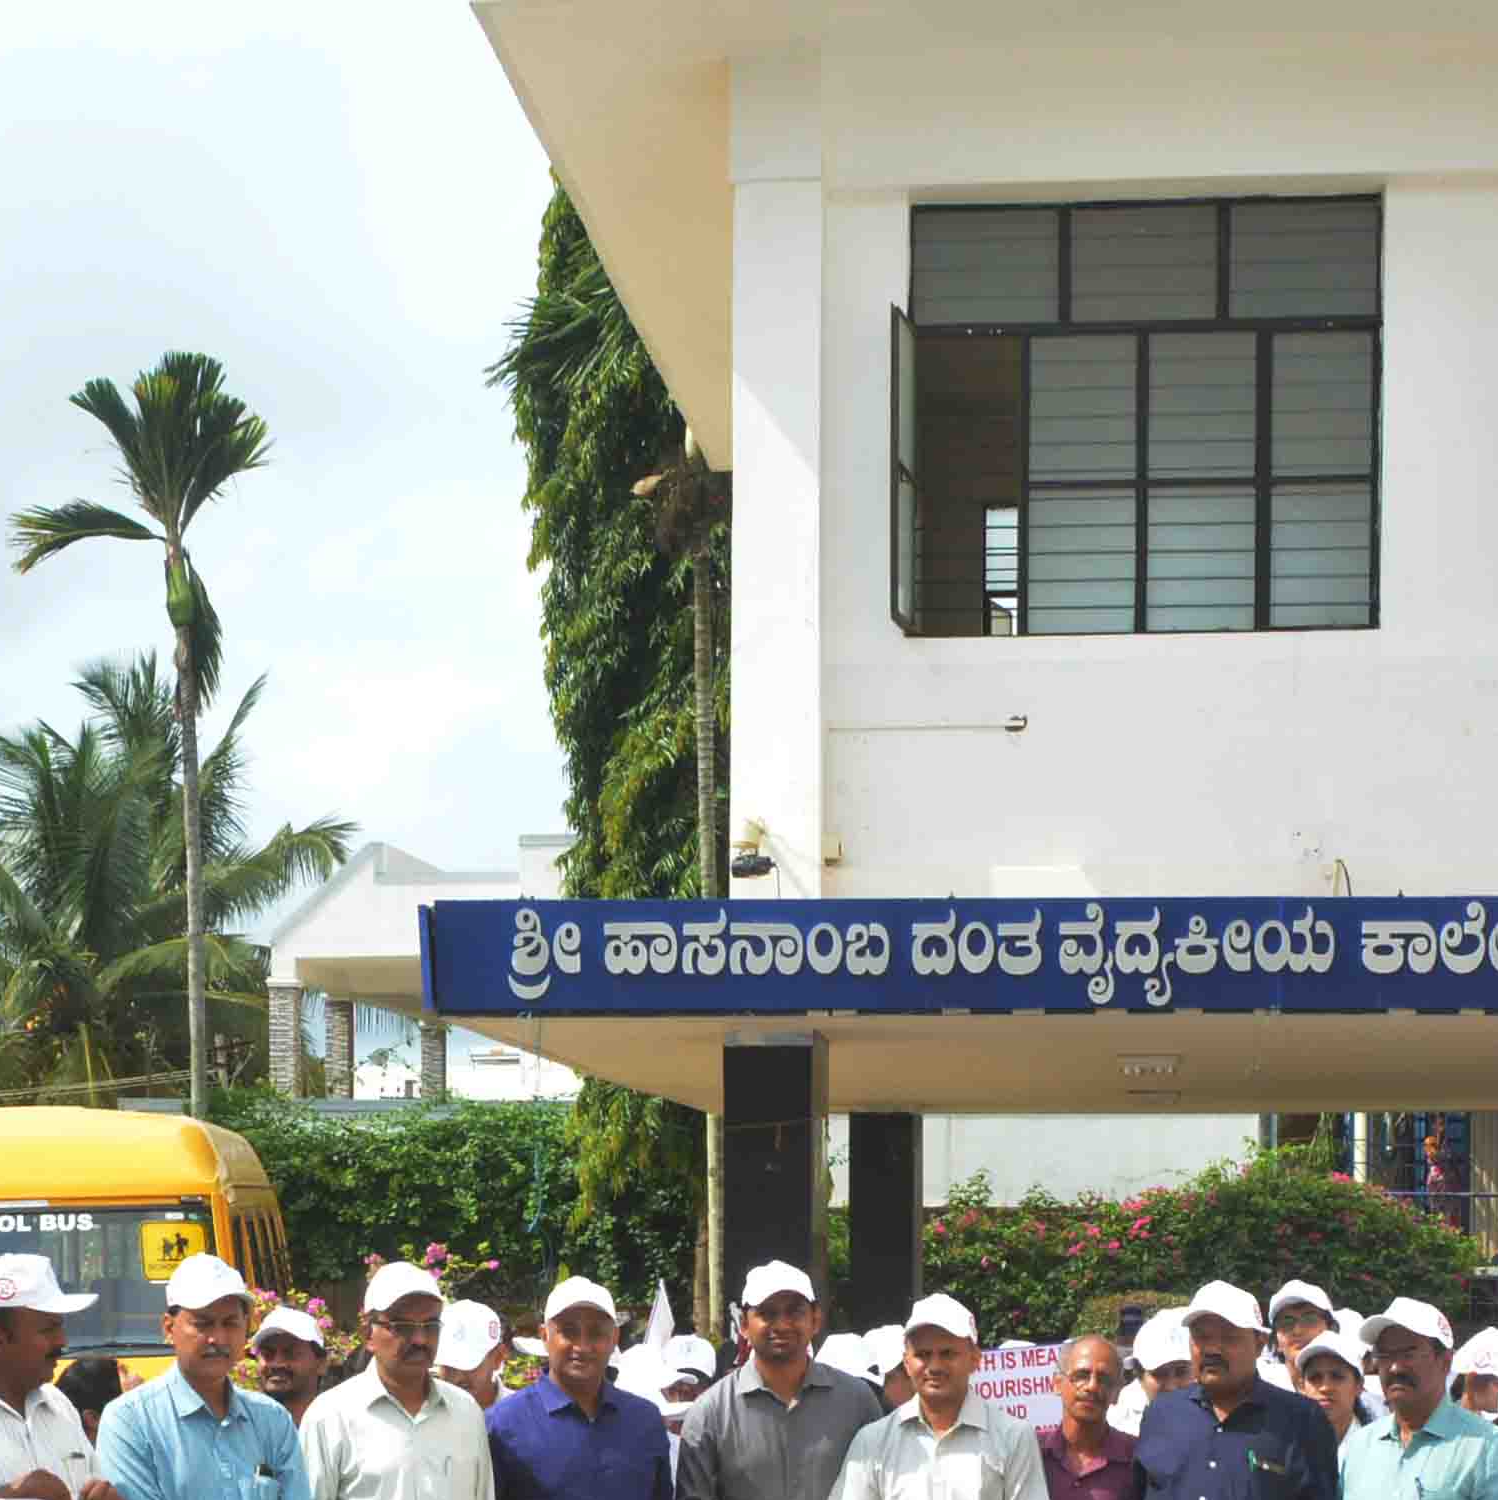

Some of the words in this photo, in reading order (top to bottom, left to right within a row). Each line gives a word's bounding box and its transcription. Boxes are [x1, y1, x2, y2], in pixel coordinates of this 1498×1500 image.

[508, 907, 582, 1000] ಶ್ರೀ
[603, 908, 890, 976] ಹಾಸನಾಂಬ
[910, 908, 1043, 975] ದಂತ
[1058, 903, 1336, 1006] ವೈದ್ಯಕೀಯ
[39, 1213, 94, 1232] BUS
[1001, 1352, 1017, 1370] IS
